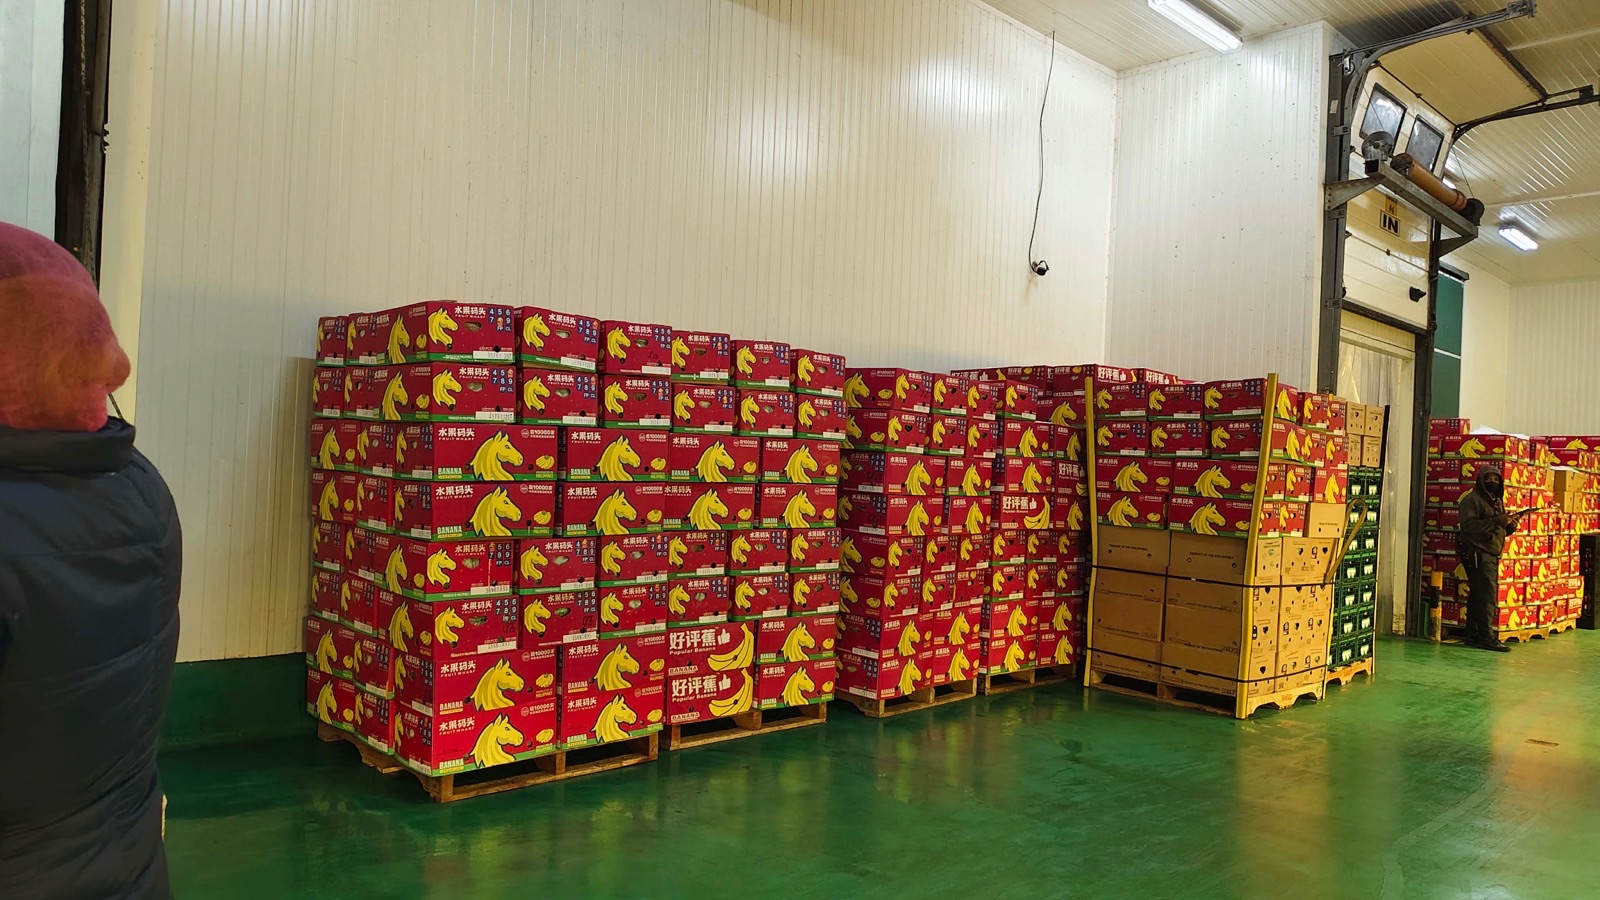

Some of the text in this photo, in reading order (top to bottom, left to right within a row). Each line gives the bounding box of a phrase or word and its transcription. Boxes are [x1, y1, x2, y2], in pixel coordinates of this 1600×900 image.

[1383, 214, 1398, 234] IN
[455, 306, 486, 315] 水果码头
[549, 313, 576, 326] 水果码头
[628, 325, 652, 334] 水果码头
[459, 367, 489, 376] 水果码头
[1098, 367, 1119, 380] 好评蕉
[548, 374, 574, 382] 水果码头
[438, 428, 475, 437] 水果码头
[572, 432, 601, 440] 水果码头
[673, 437, 699, 445] 水果码头
[1059, 463, 1079, 476] 好评蕉
[436, 485, 473, 495] 水果码头
[568, 487, 597, 496] 水果码头
[1002, 495, 1029, 510] 好评蕉
[437, 526, 462, 534] BANANA
[623, 536, 648, 545] 水果码头
[622, 587, 647, 596] 水果码头
[548, 593, 574, 601] 水果码头
[462, 602, 492, 610] 水果码头
[669, 629, 716, 650] 好评蕉
[569, 644, 598, 655] 水果码头
[440, 659, 476, 673] 水果码头
[670, 666, 697, 674] BANANA
[763, 666, 785, 675] 水果码头
[568, 680, 588, 690] BANANA
[672, 675, 718, 697] 好评蕉
[440, 700, 463, 711] BANANA
[568, 696, 597, 707] 水果码头
[672, 712, 699, 721] BANANA
[439, 717, 475, 731] 水果码头
[567, 734, 587, 743] BANANA
[439, 759, 464, 769] BANANA
